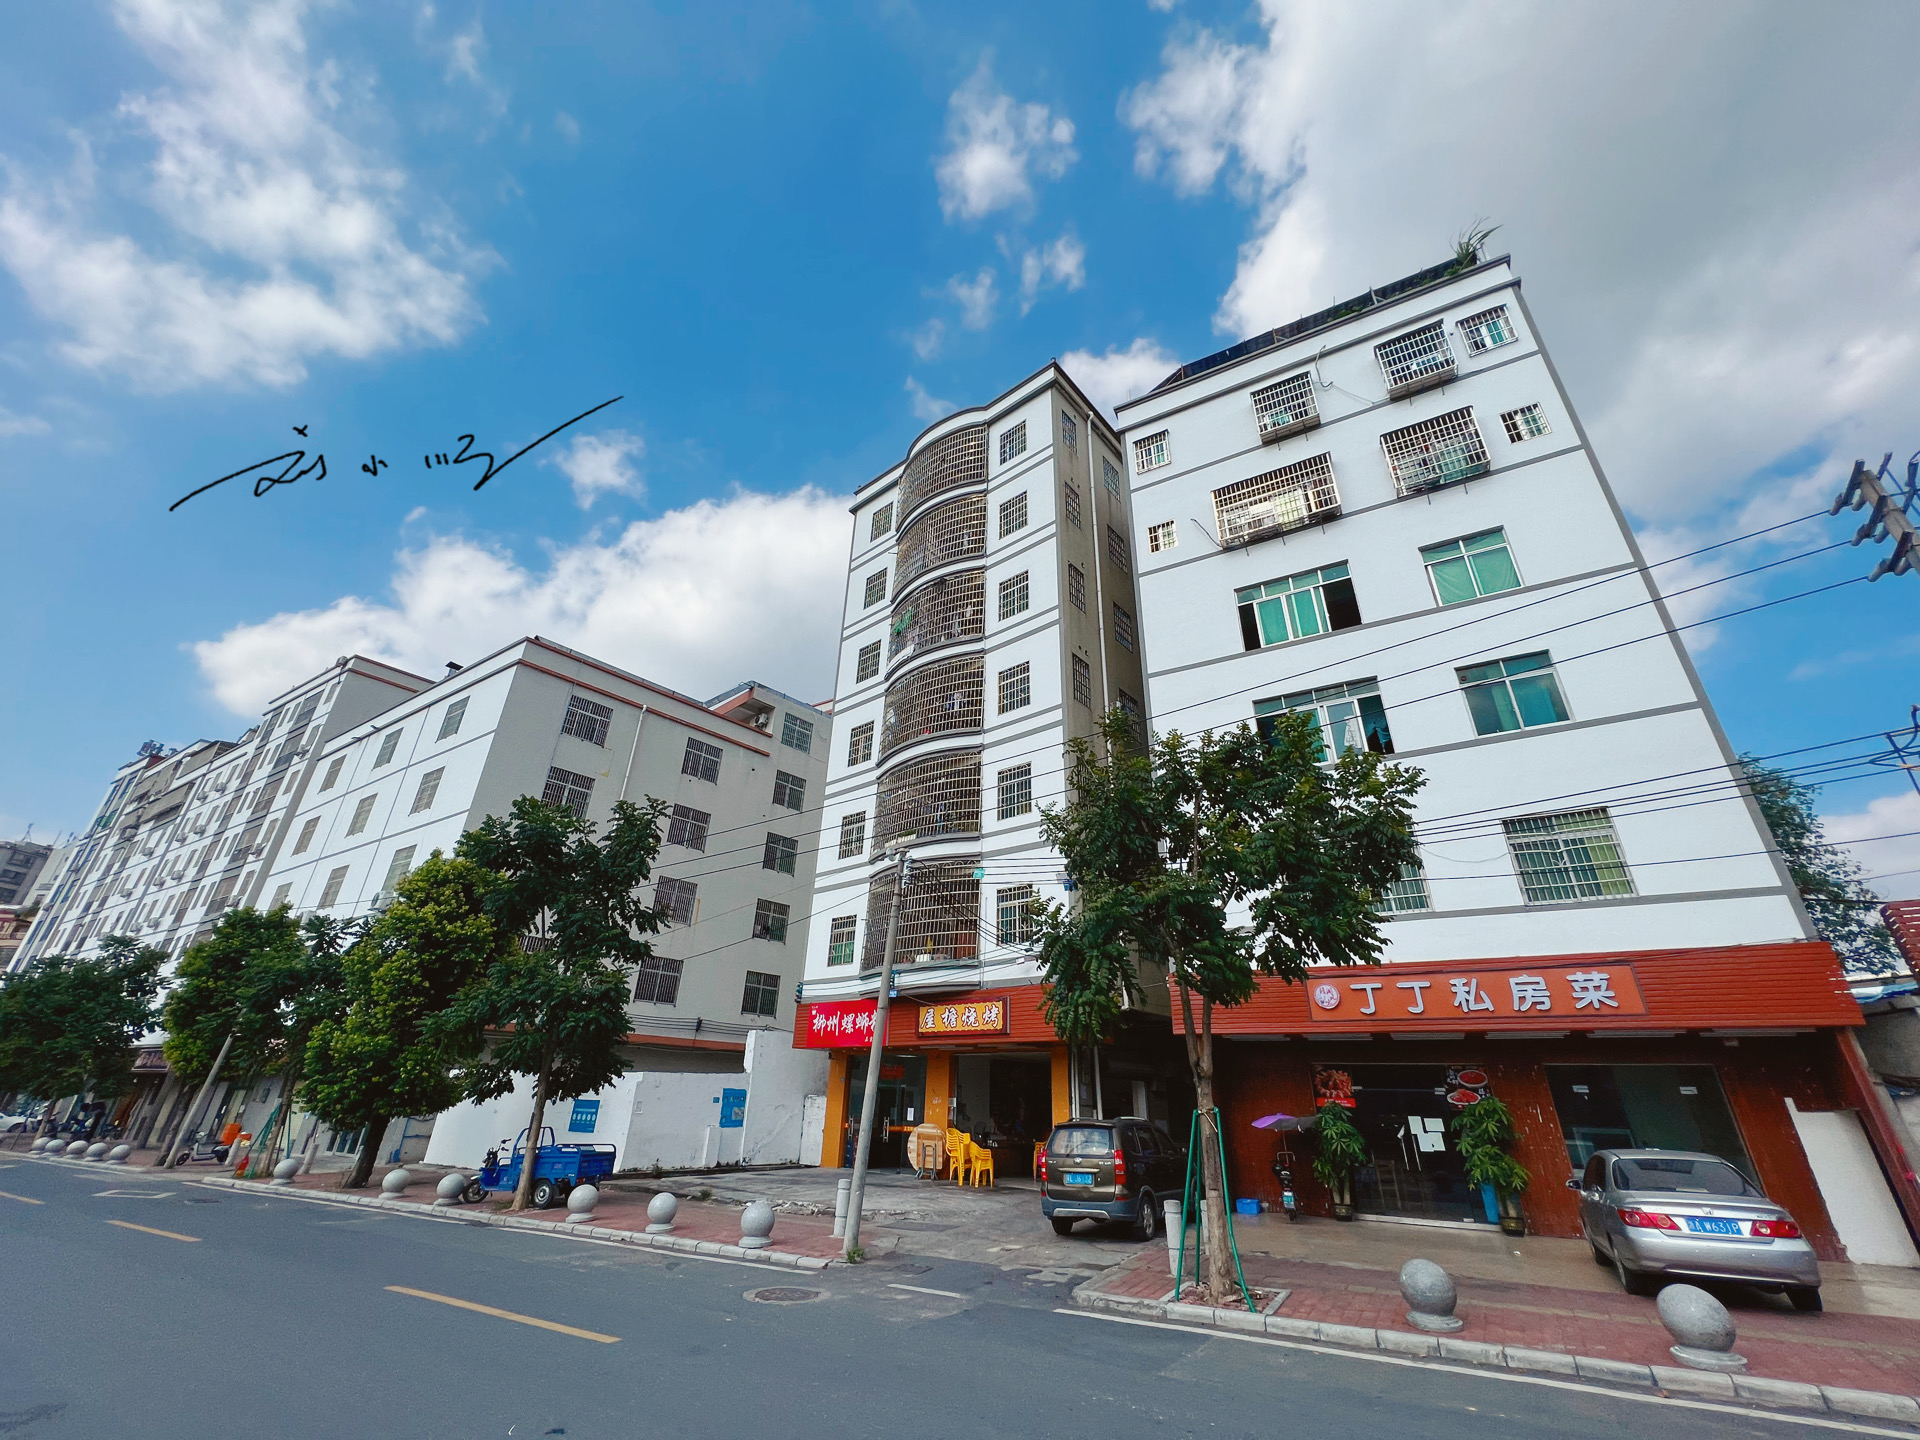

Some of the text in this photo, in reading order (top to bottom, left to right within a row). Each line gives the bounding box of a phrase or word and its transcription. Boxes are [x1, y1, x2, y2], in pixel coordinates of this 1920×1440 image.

[1349, 971, 1619, 1014] 丁丁私房菜
[920, 1004, 1000, 1029] 屋檐烧烤
